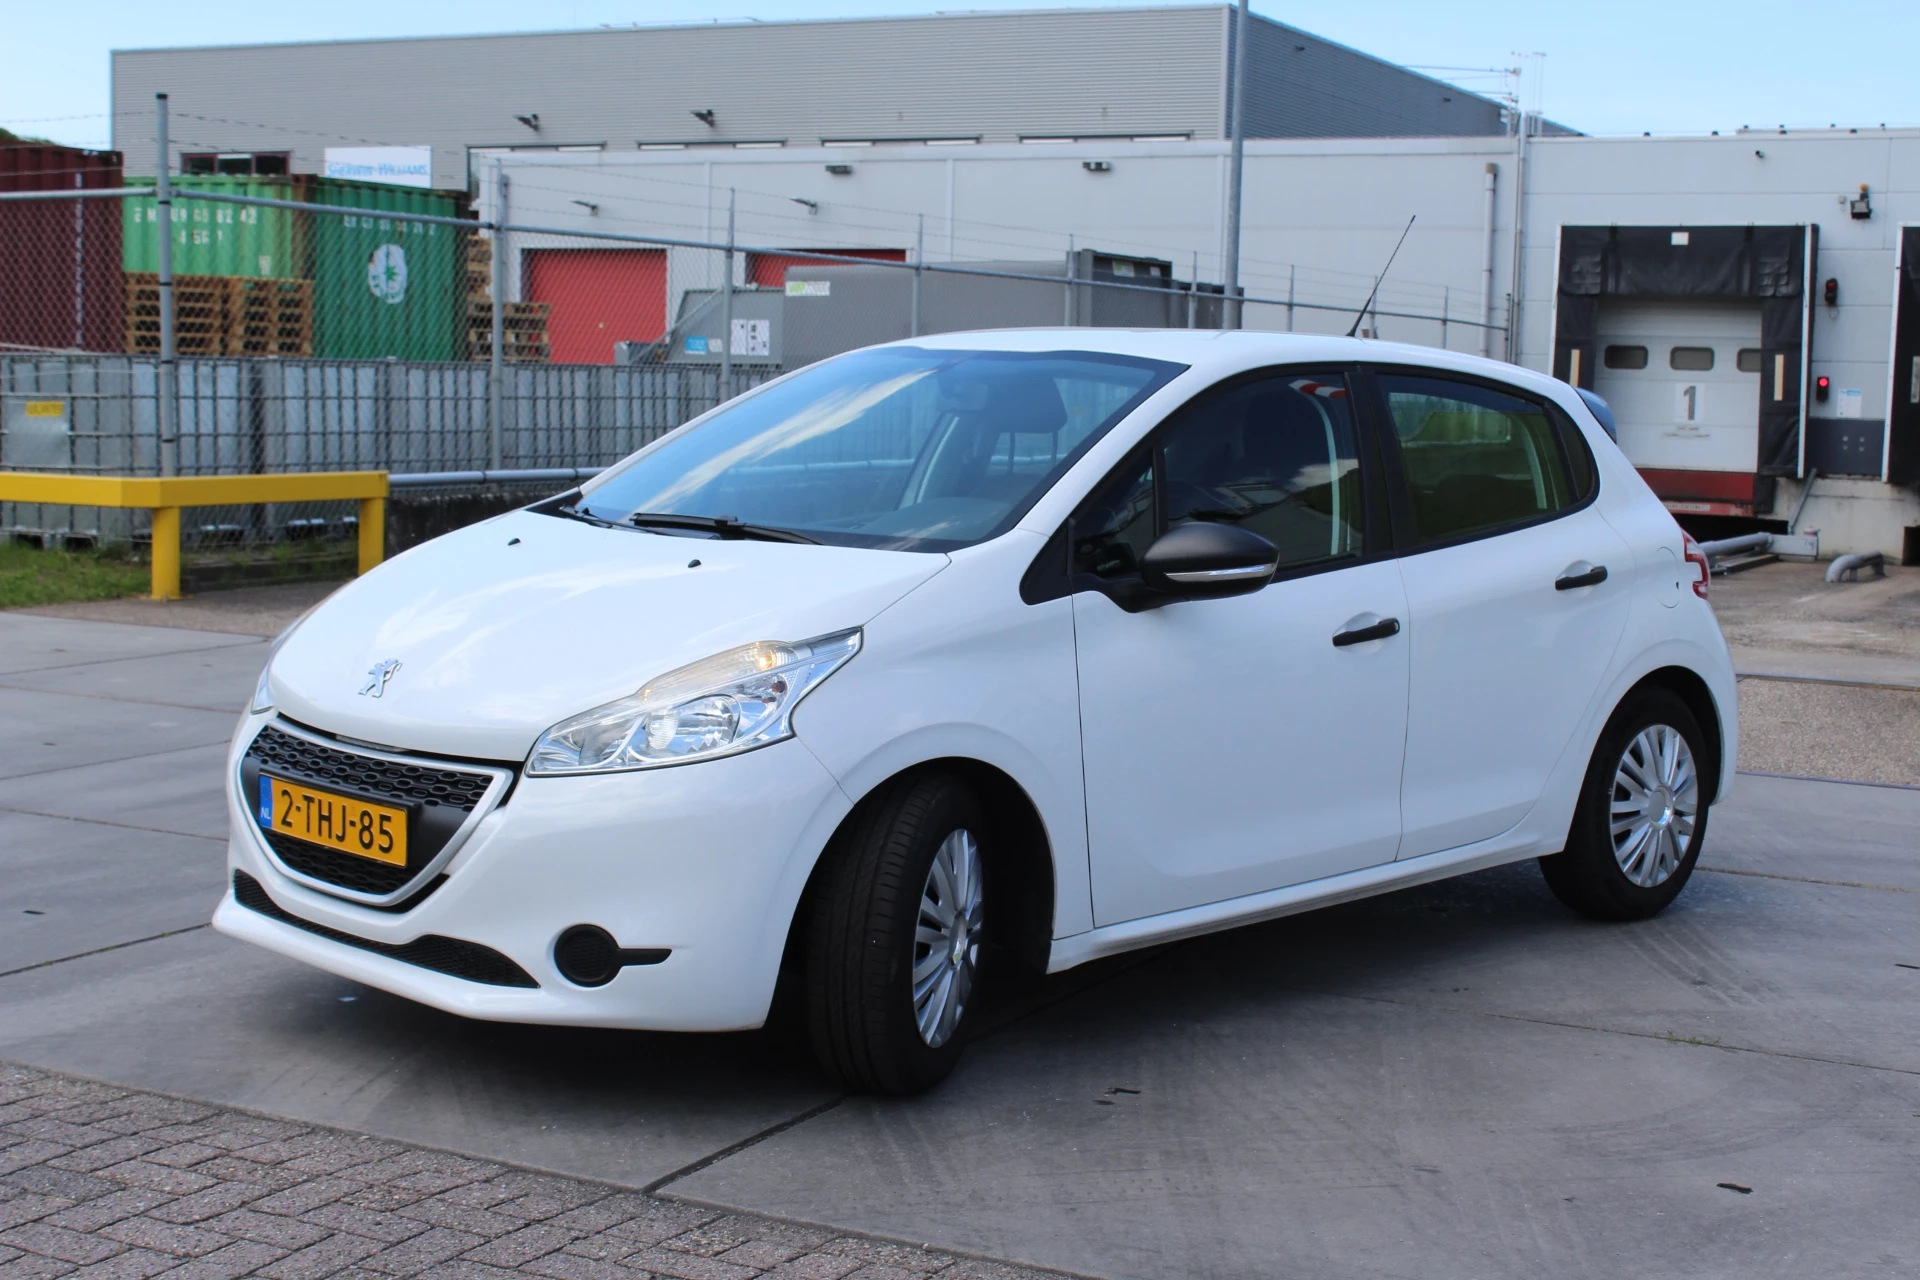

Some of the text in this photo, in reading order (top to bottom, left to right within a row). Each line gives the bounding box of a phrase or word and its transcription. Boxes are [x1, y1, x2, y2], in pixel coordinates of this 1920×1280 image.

[1683, 385, 1697, 421] 1
[260, 788, 394, 854] NL 2-THJ-85
